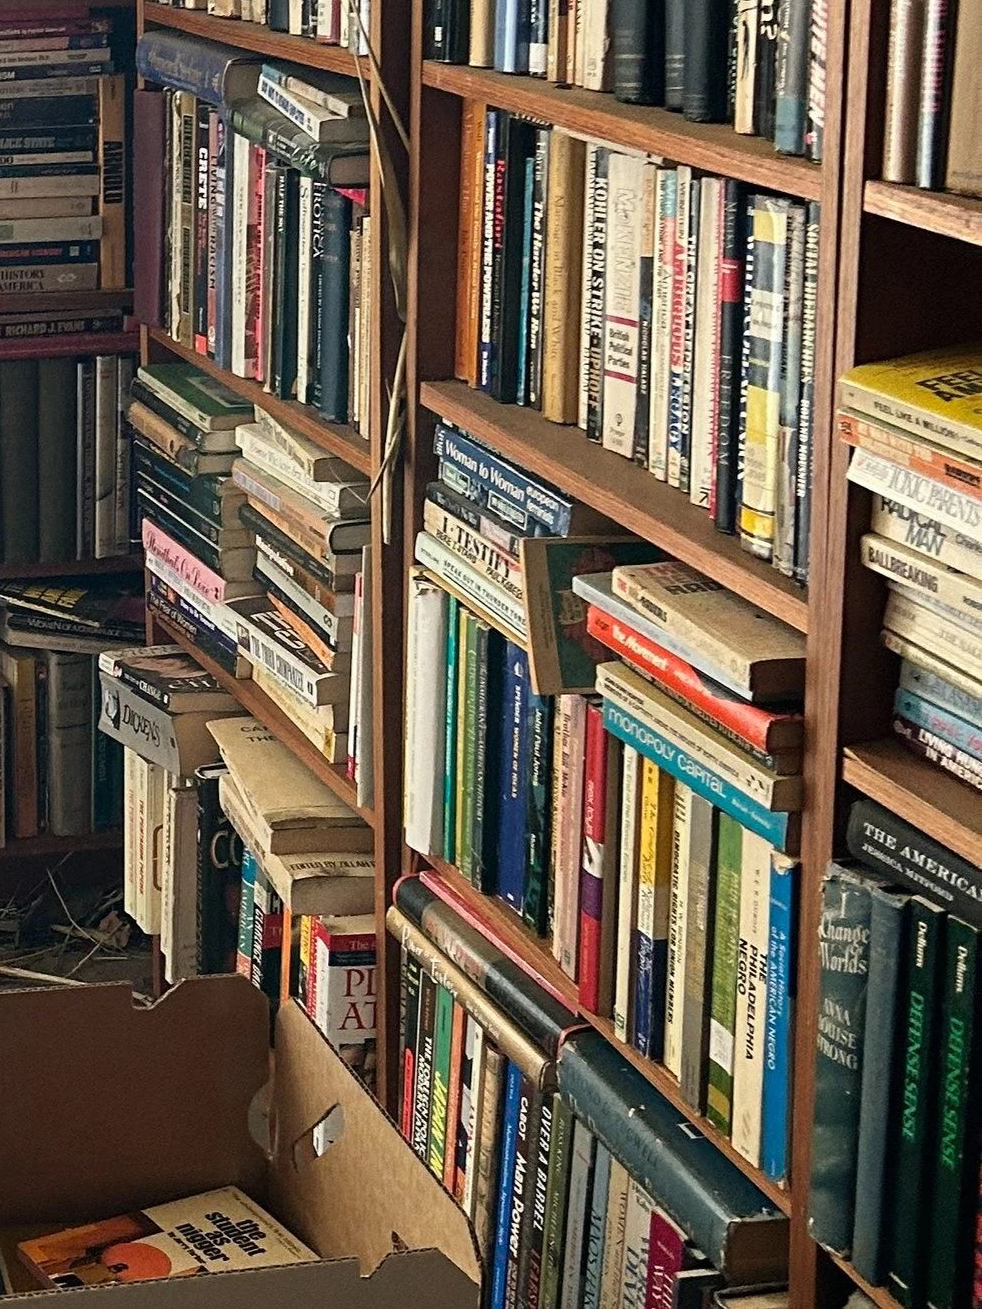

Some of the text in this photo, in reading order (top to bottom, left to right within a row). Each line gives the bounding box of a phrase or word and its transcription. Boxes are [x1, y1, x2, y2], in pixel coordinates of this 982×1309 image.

[807, 61, 827, 129] MEN
[198, 147, 208, 211] CRETE
[595, 177, 608, 238] KOHLER
[593, 240, 607, 267] ON
[591, 268, 606, 331] STRIKE
[445, 440, 477, 473] Woman
[478, 463, 489, 479] to
[490, 466, 525, 502] Woman
[927, 482, 981, 527] PARENTS
[904, 524, 945, 557] MAN
[868, 546, 939, 593] BALLBREAKING
[122, 705, 161, 747] DICKENS
[863, 821, 897, 851] THE
[818, 911, 870, 944] Change
[737, 937, 749, 996] NEGRO
[756, 952, 768, 985] THE
[745, 943, 760, 1061] PHILADELPHIA
[901, 990, 926, 1143] DEFENSE SENSE
[518, 1096, 529, 1140] CABOT
[540, 1106, 552, 1149] OVER
[940, 1101, 959, 1172] SENSE
[533, 1168, 548, 1232] BARREL
[175, 1223, 230, 1261] nigger
[204, 1231, 231, 1246] as
[205, 1211, 266, 1257] student
[236, 1219, 266, 1240] the
